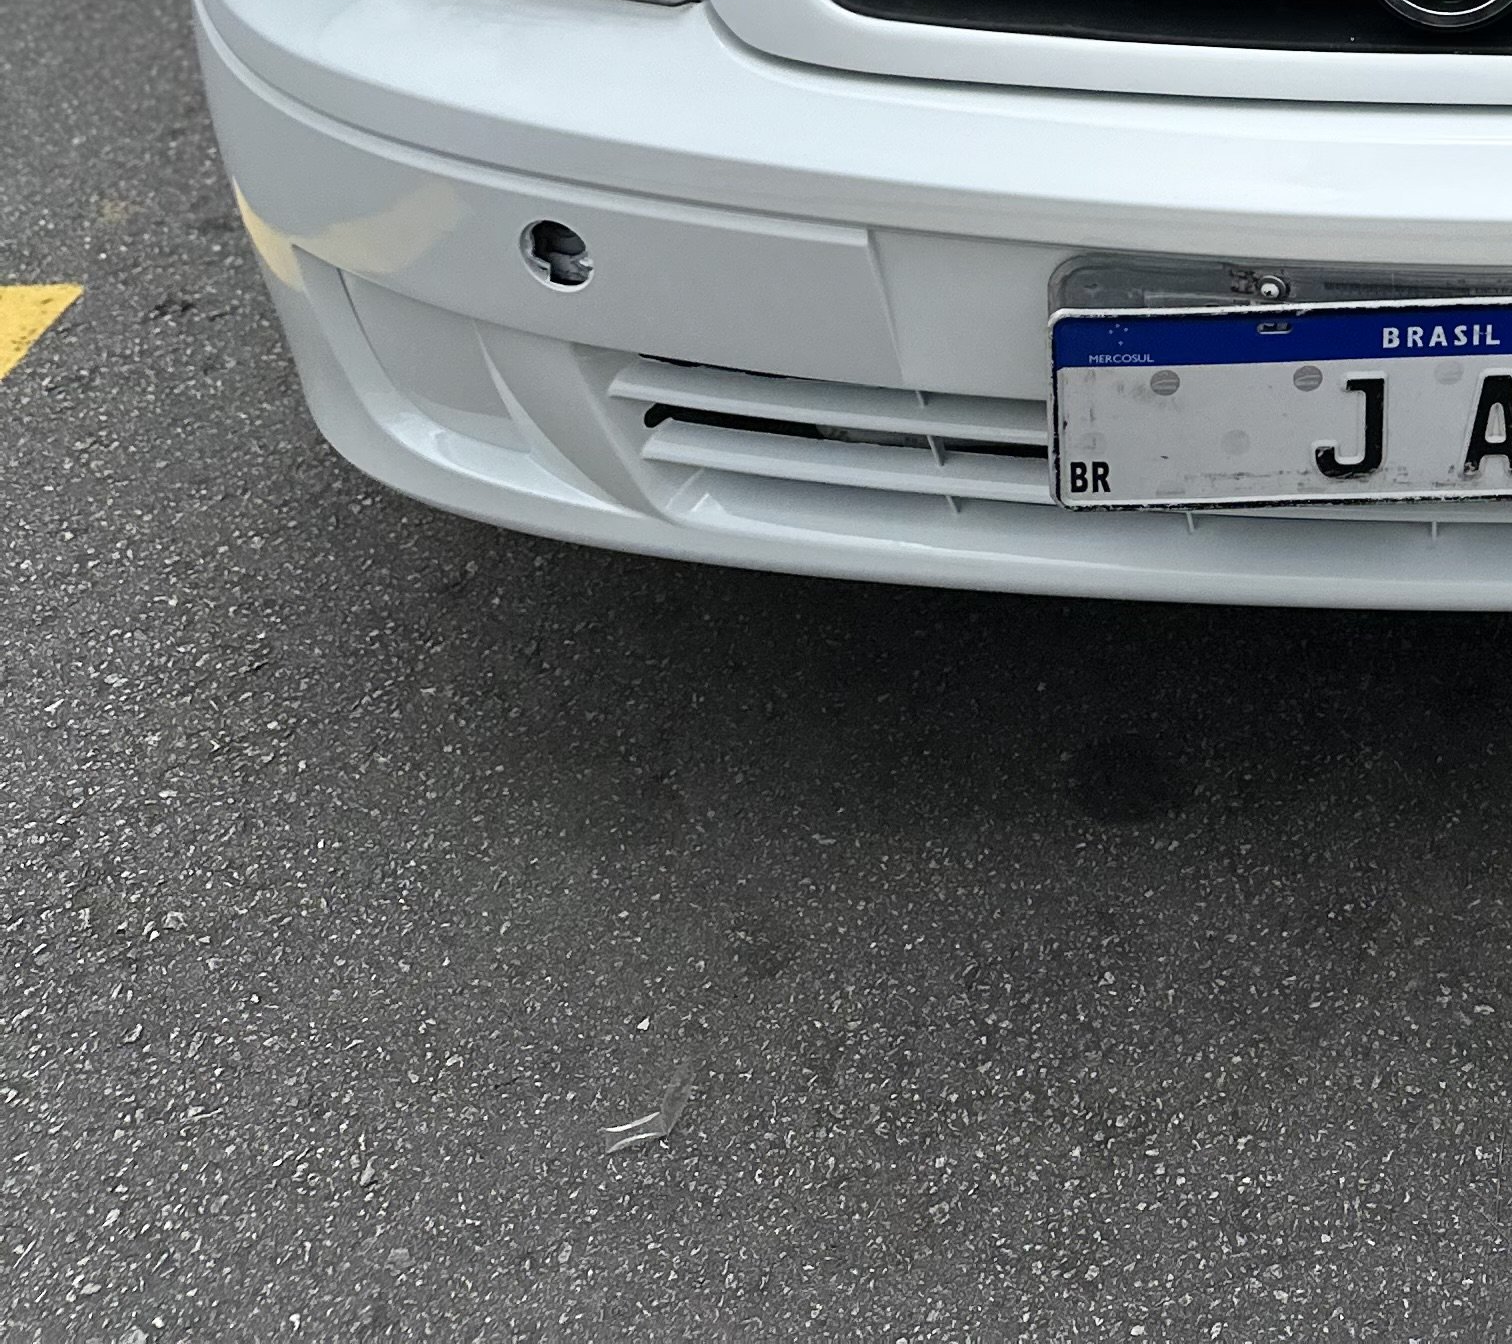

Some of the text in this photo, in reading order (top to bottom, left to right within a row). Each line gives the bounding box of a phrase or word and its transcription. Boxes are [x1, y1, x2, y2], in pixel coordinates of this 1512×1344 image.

[1382, 324, 1501, 349] BRASIL
[1088, 353, 1155, 364] MERCOSUL
[1314, 377, 1385, 479] J
[1070, 461, 1111, 493] BR
